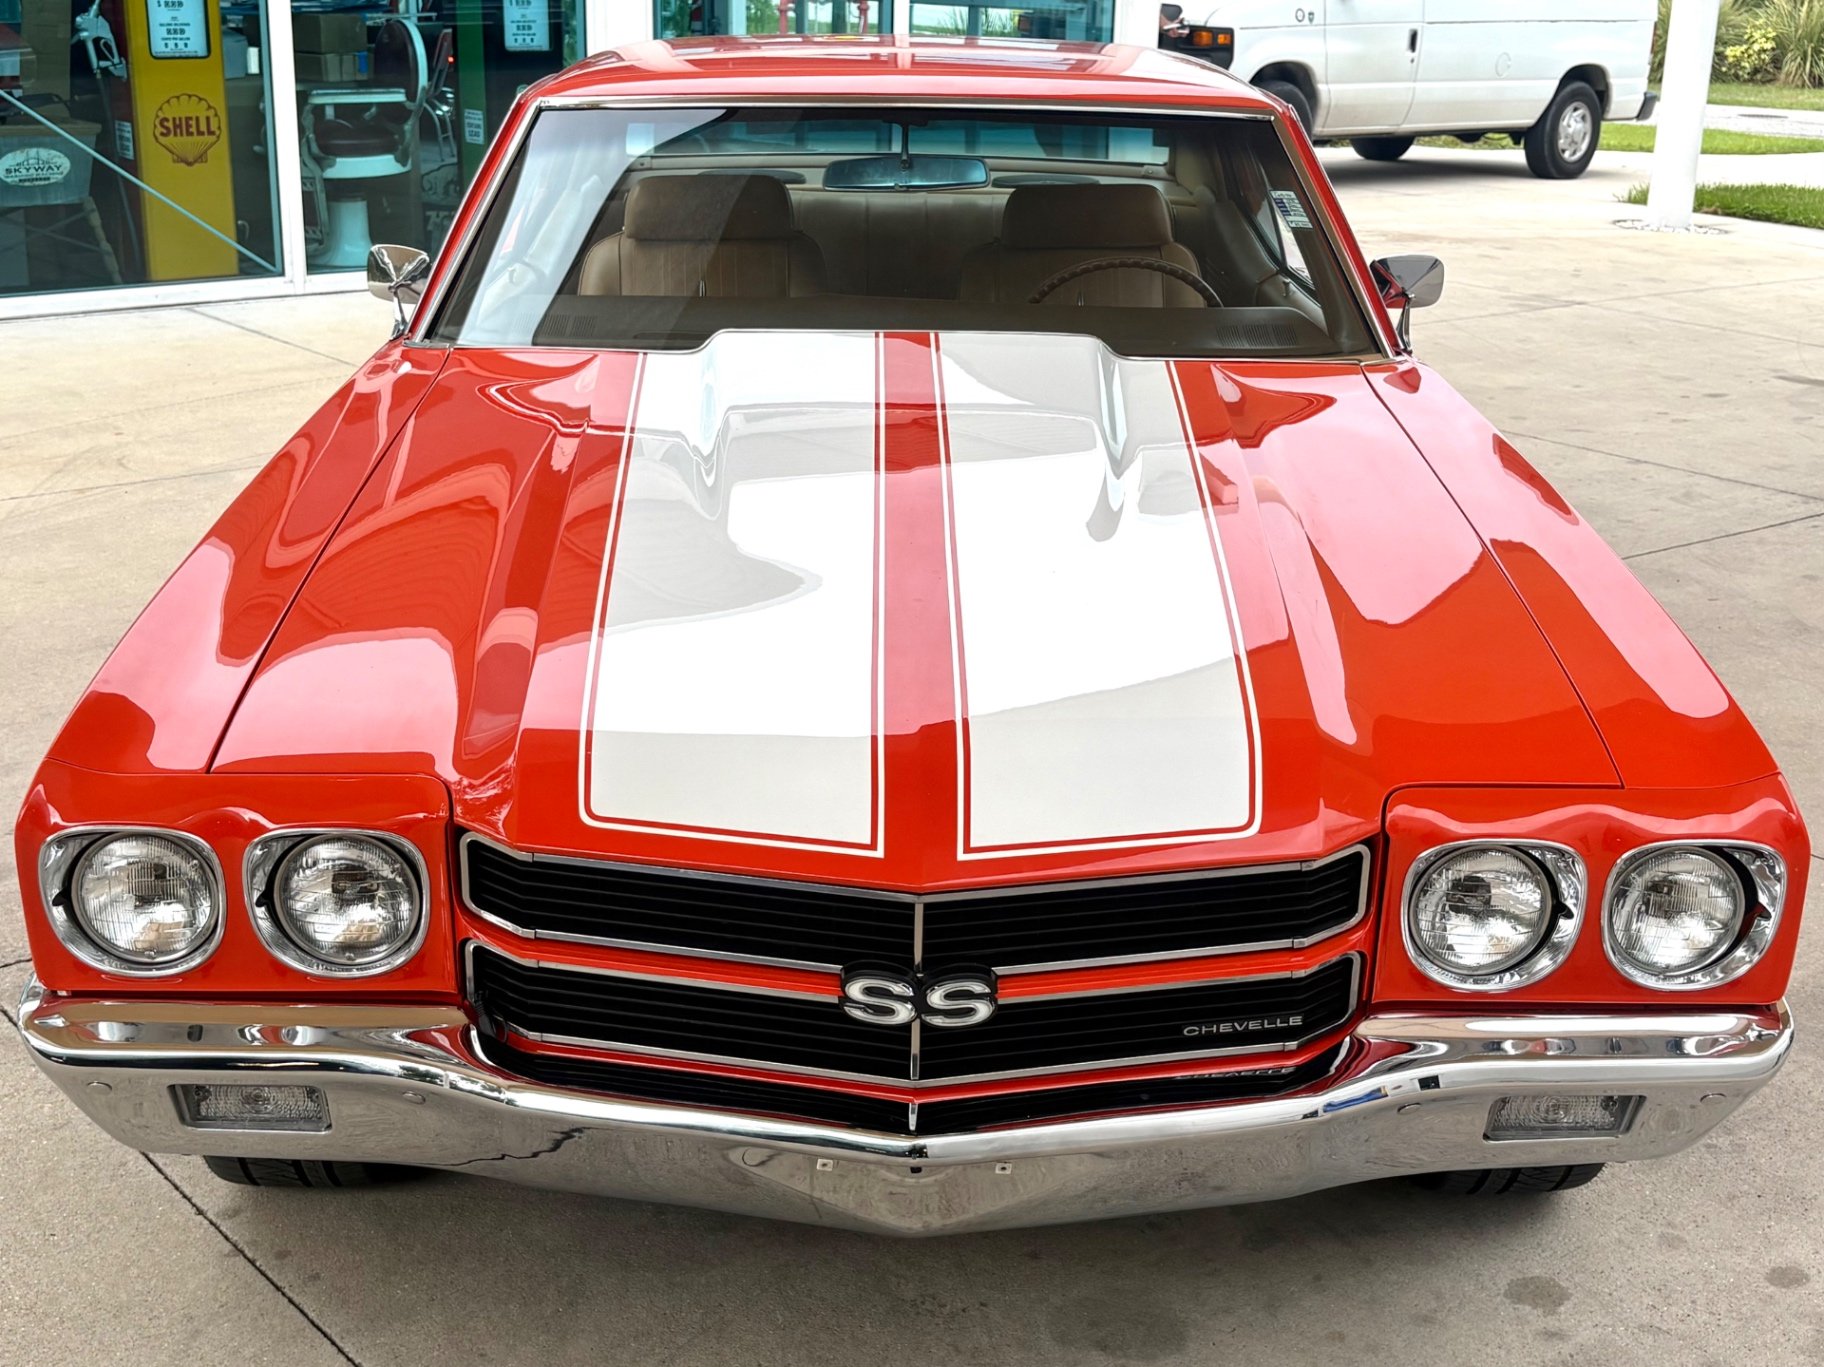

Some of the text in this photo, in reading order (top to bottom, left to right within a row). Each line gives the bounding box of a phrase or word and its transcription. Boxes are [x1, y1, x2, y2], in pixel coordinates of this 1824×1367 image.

[159, 116, 216, 137] SHELL
[5, 164, 62, 175] SKYWAY
[844, 976, 995, 1027] SS
[1183, 1016, 1303, 1036] CHEVELLE
